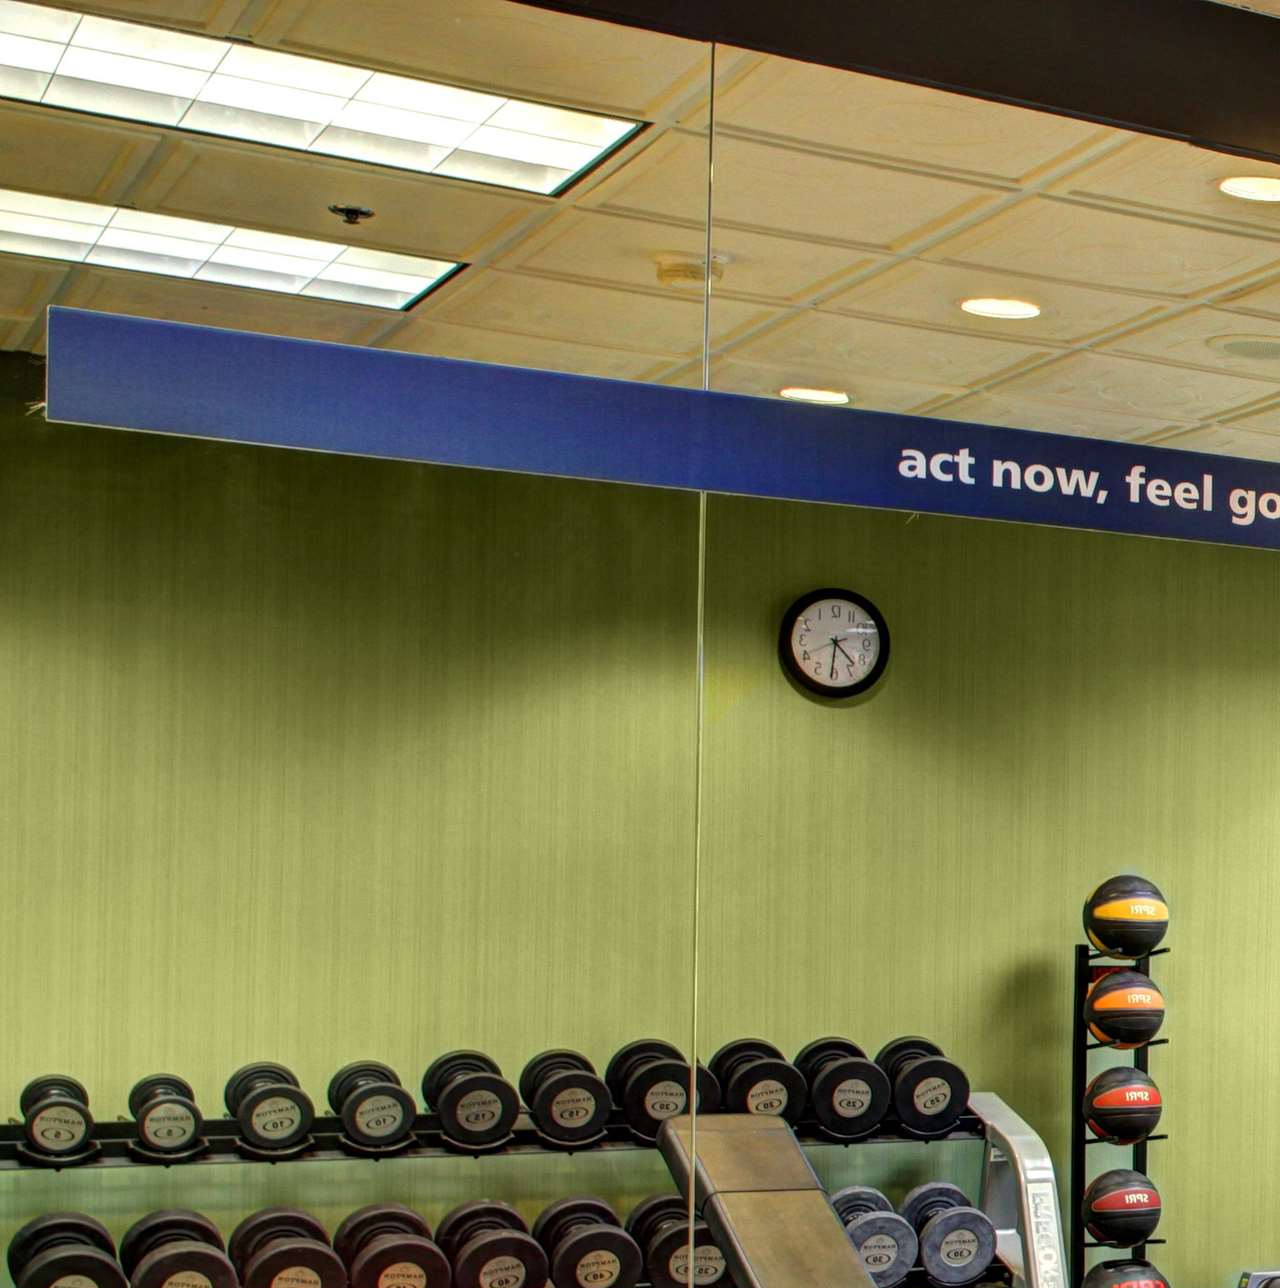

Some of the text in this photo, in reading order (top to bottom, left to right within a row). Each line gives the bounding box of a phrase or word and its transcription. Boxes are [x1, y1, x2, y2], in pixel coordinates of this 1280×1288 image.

[898, 447, 975, 485] act
[992, 457, 1109, 504] now,
[1125, 465, 1213, 512] feel
